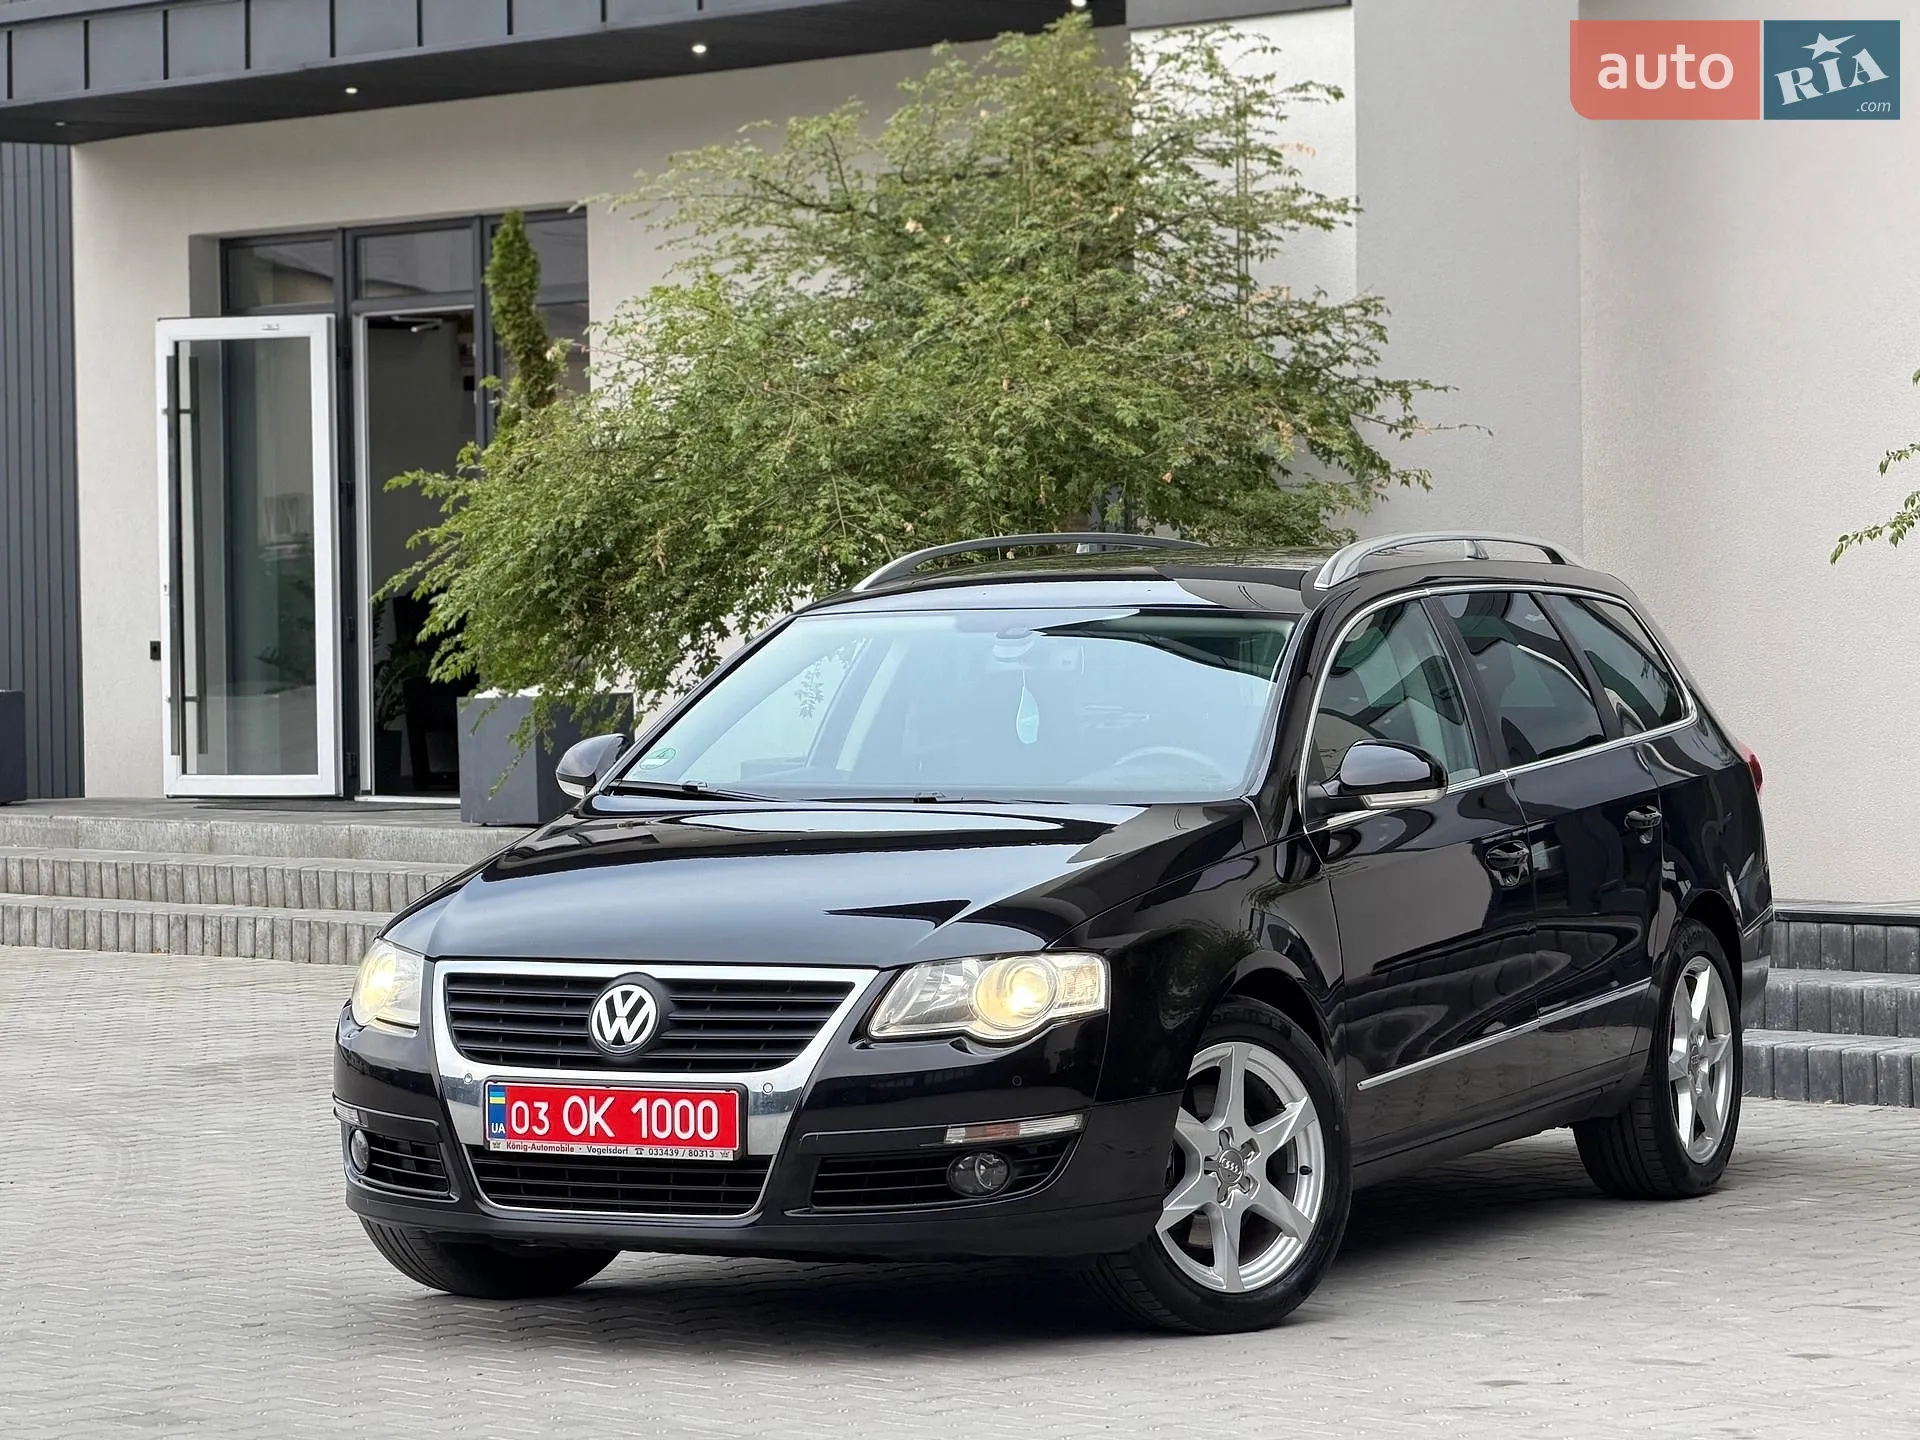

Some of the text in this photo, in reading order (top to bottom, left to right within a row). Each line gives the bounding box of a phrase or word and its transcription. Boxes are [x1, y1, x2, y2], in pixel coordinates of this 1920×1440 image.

[591, 985, 657, 1048] VW
[491, 1122, 506, 1134] UA
[510, 1095, 719, 1140] 03 OK 1000
[506, 1141, 575, 1154] König-Automobile
[586, 1145, 629, 1156] Vogelsdorf
[648, 1148, 680, 1157] 033439
[688, 1149, 715, 1158] 80313
